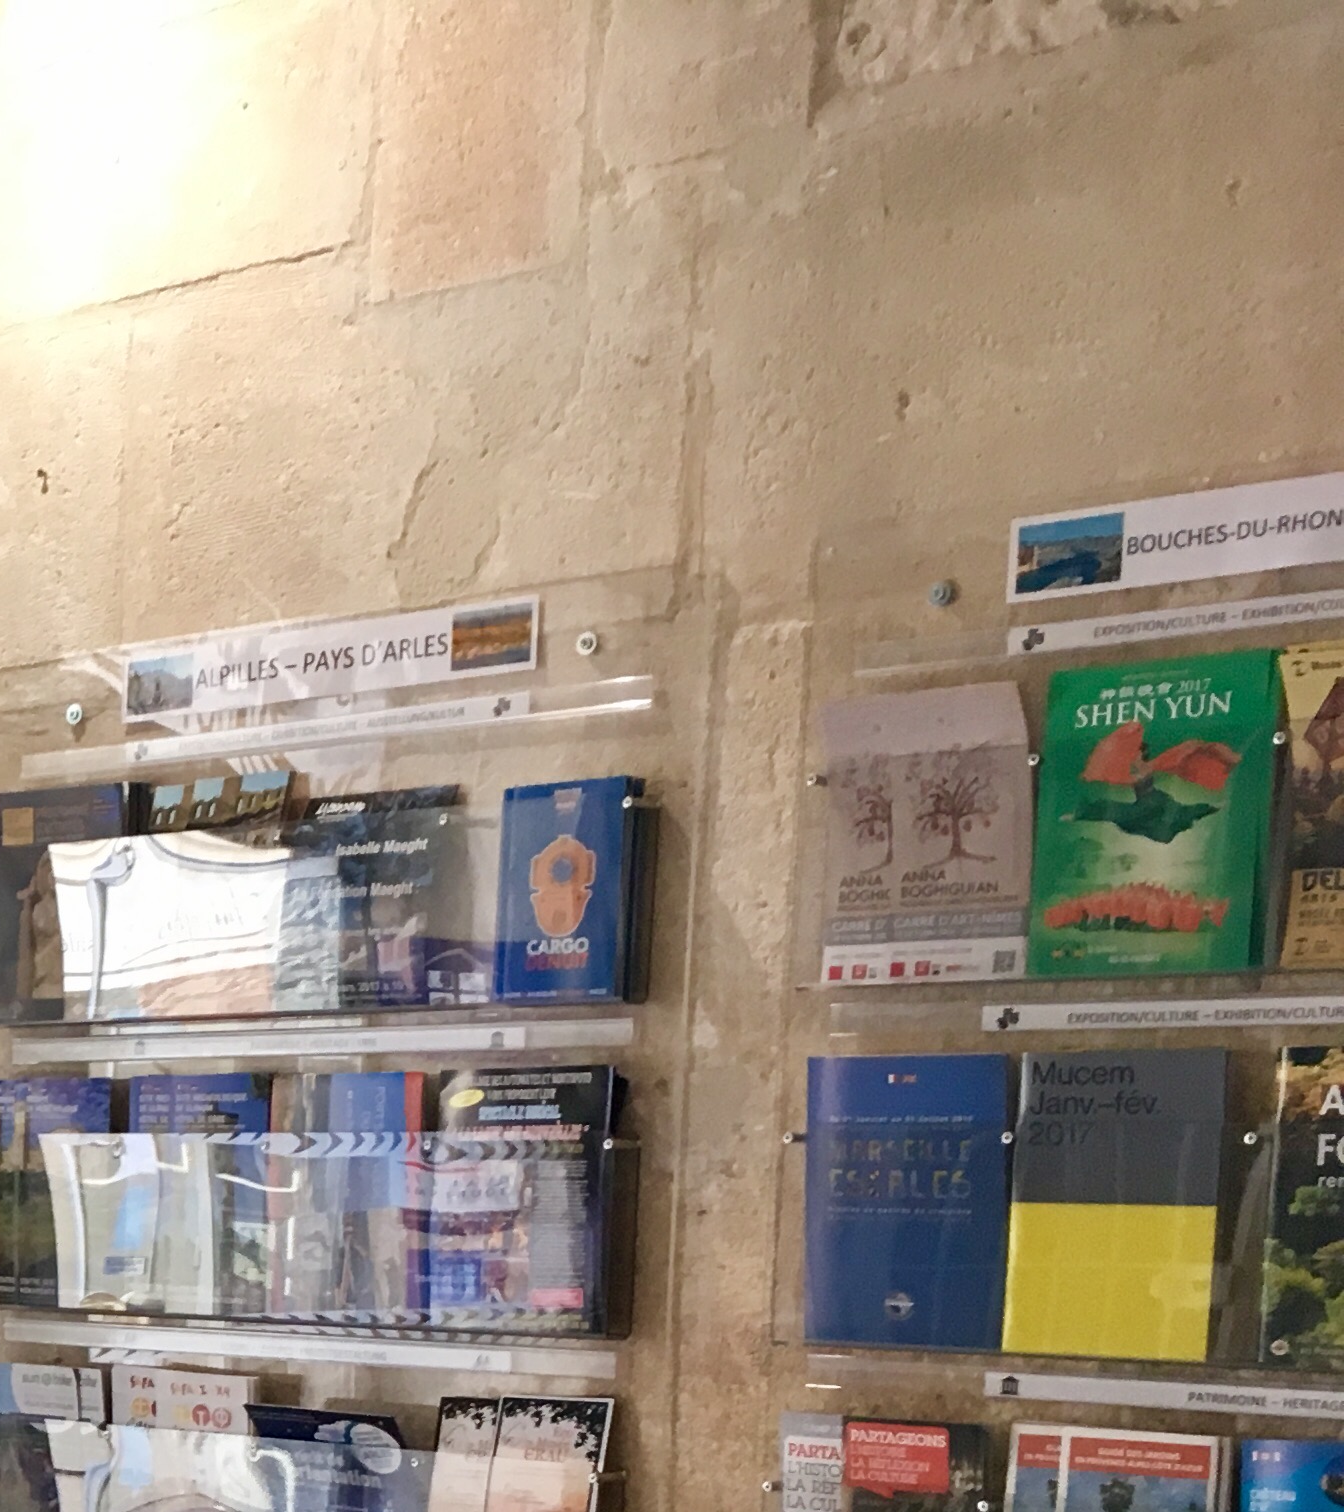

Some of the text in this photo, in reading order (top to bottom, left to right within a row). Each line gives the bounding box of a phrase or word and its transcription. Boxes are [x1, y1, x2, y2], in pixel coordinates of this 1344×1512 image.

[196, 633, 450, 690] ALPILLES PAYS D'ARLES
[1177, 677, 1212, 694] 2017
[1075, 696, 1157, 729] SHEN
[1165, 689, 1233, 720] YUN
[838, 875, 884, 889] ANNA
[900, 870, 947, 883] ANNA
[526, 937, 590, 957] CARGO
[1030, 1060, 1135, 1087] Mucem
[1027, 1122, 1095, 1146] 2017
[849, 1428, 947, 1448] PARTAGEONS
[788, 1442, 841, 1461] PARTA
[850, 1470, 865, 1480] LA
[786, 1478, 806, 1493] LA
[786, 1495, 807, 1511] LA
